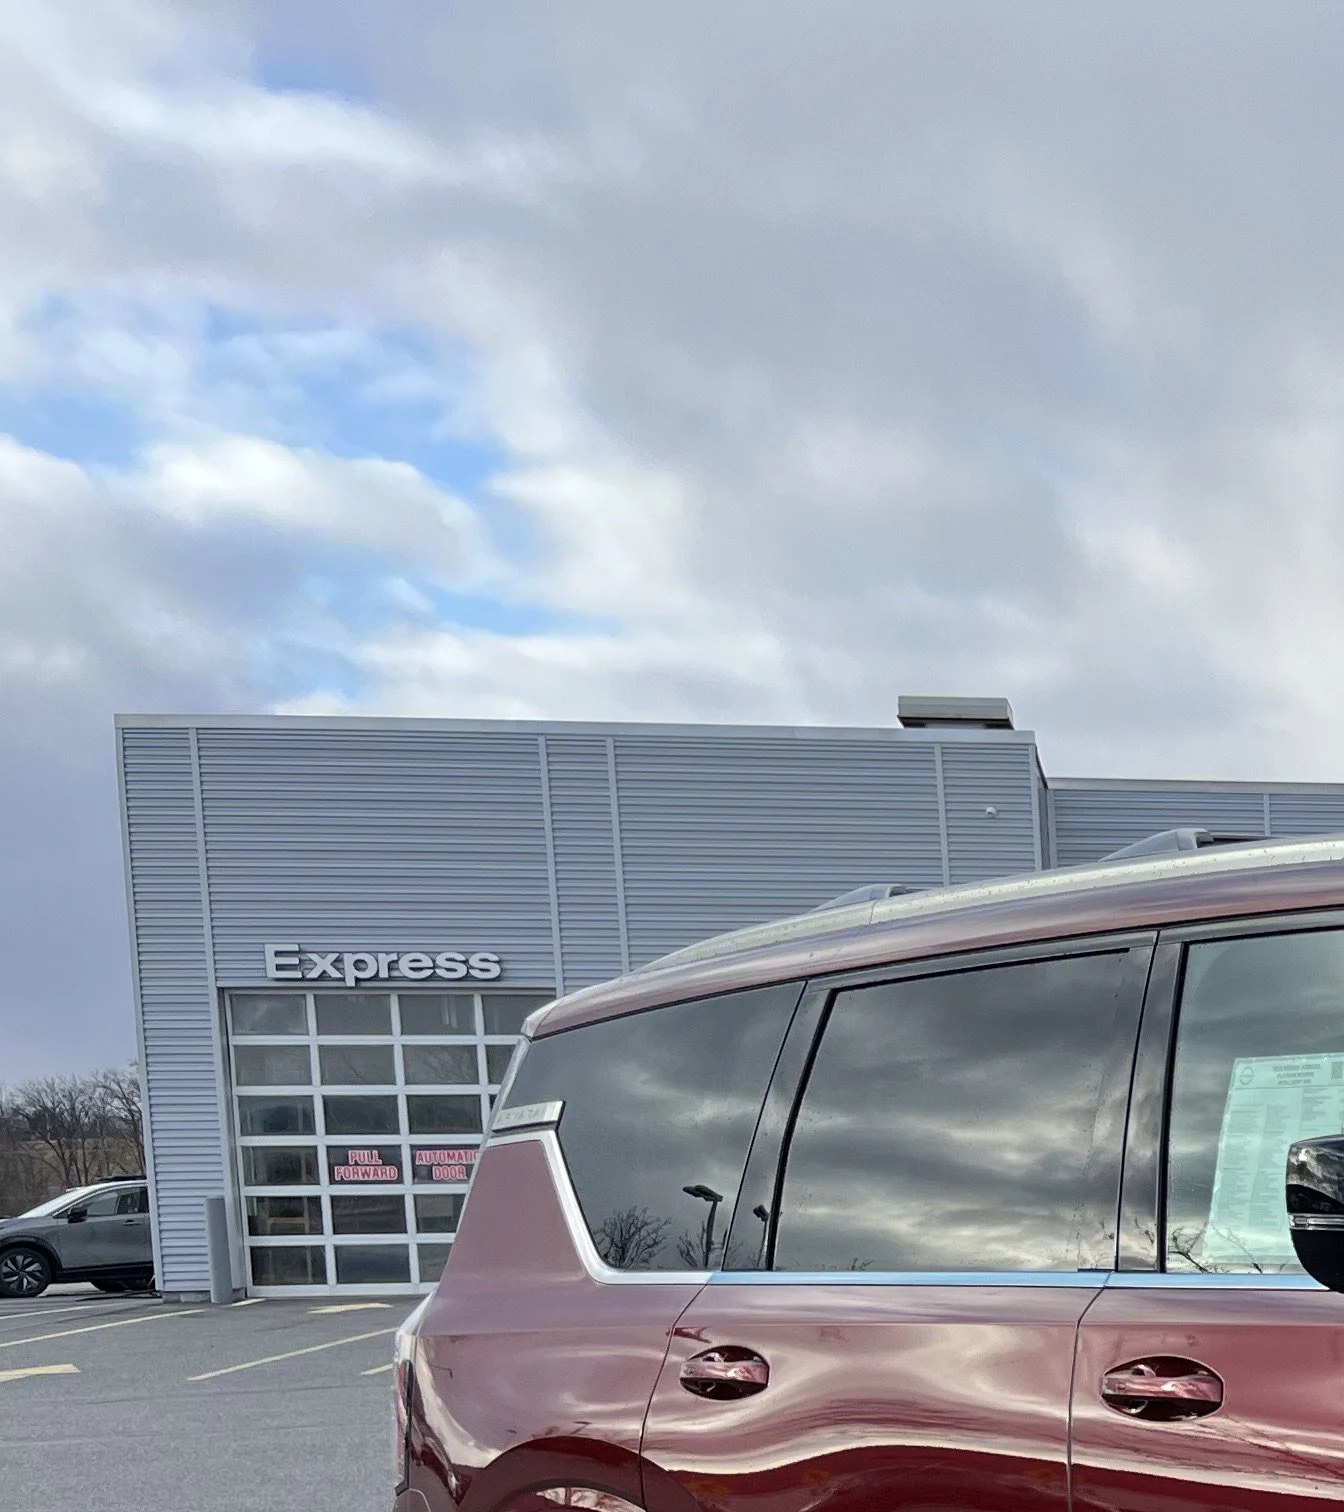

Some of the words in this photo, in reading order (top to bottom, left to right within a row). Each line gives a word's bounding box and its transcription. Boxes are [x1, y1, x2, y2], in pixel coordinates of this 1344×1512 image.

[264, 943, 502, 987] Express
[348, 1150, 382, 1165] PULL
[335, 1165, 399, 1181] FORWARD
[432, 1165, 467, 1180] DOOR
